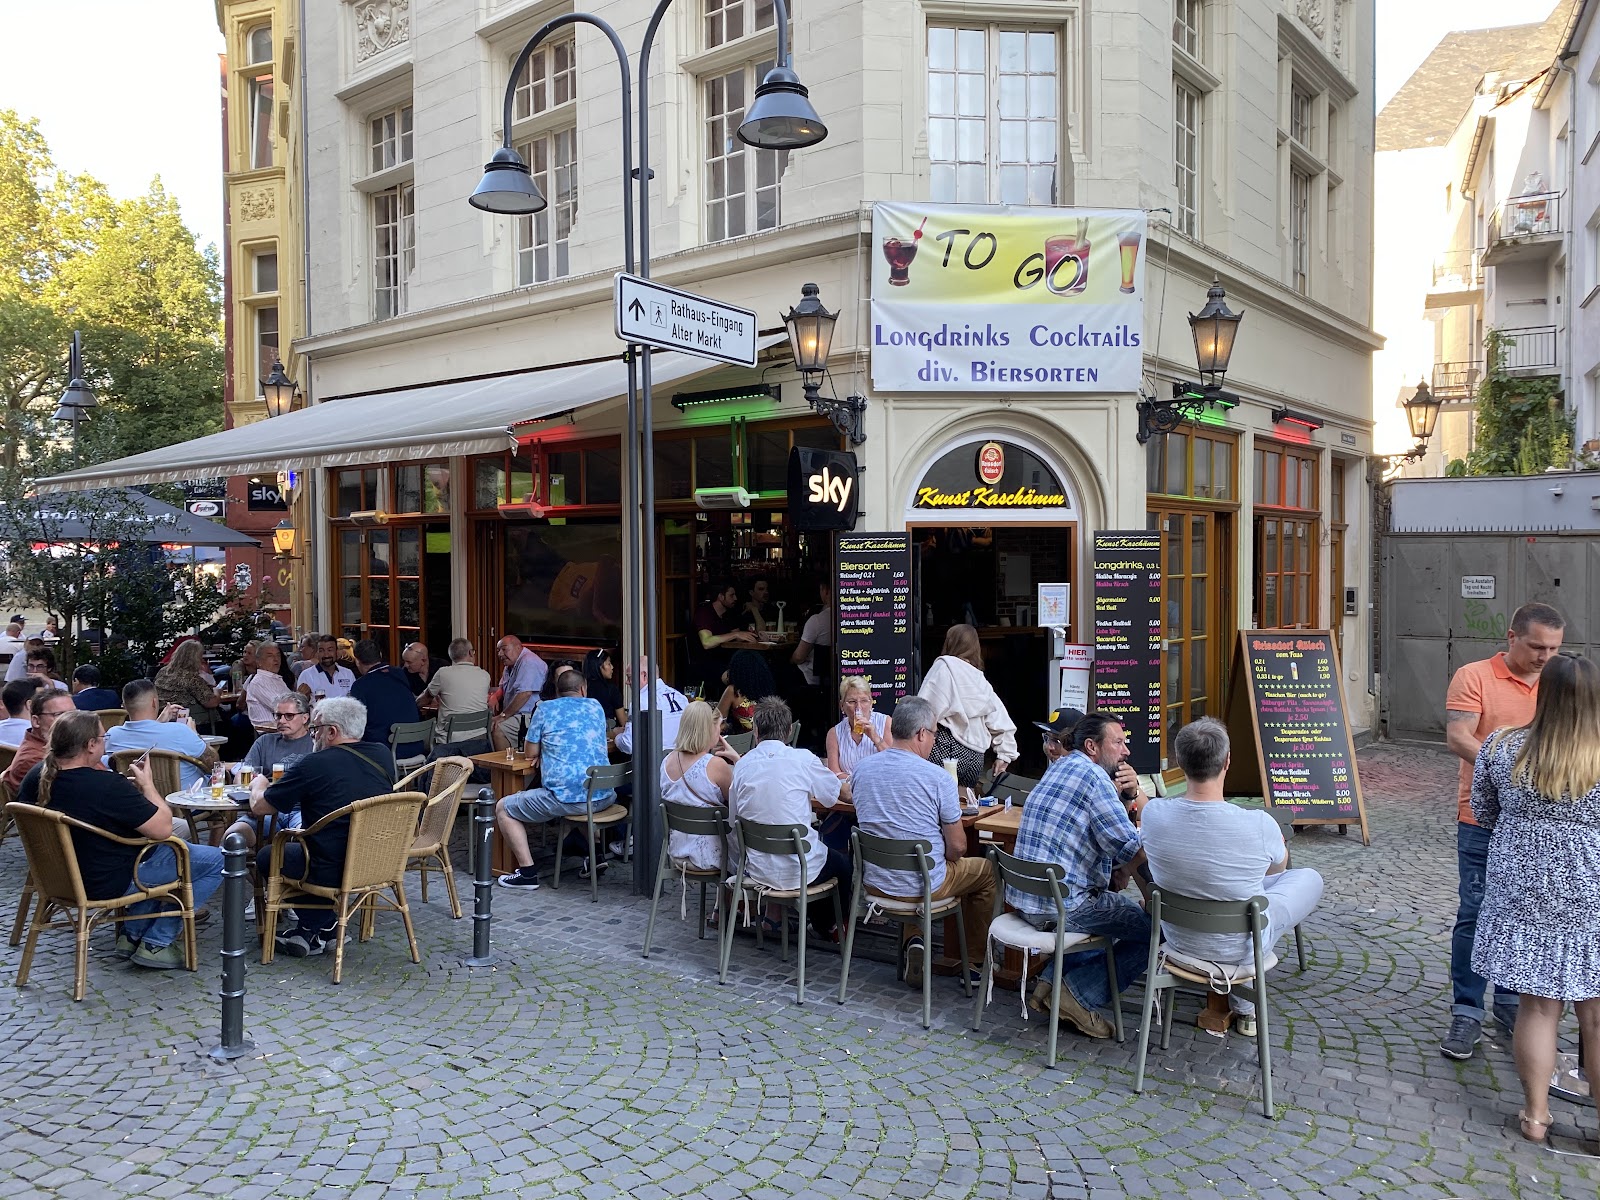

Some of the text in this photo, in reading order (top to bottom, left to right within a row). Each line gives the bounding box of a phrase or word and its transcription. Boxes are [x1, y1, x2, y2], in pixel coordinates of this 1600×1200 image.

[936, 229, 1083, 294] TO GO
[671, 299, 744, 337] Rathaus-Eingang
[671, 323, 722, 350] Alter Markt
[625, 352, 630, 361] 2
[917, 359, 959, 382] div.
[252, 486, 281, 504] sky
[808, 466, 853, 512] sky
[918, 486, 1064, 506] Kunst Kaschämm
[840, 541, 906, 549] Kunst Kaschämm
[1095, 538, 1160, 547] Kunst Kaschämm
[840, 562, 890, 571] Biersorten:
[1093, 560, 1145, 571] Longdrinks,
[662, 692, 683, 713] K
[1290, 776, 1308, 784] Lemon
